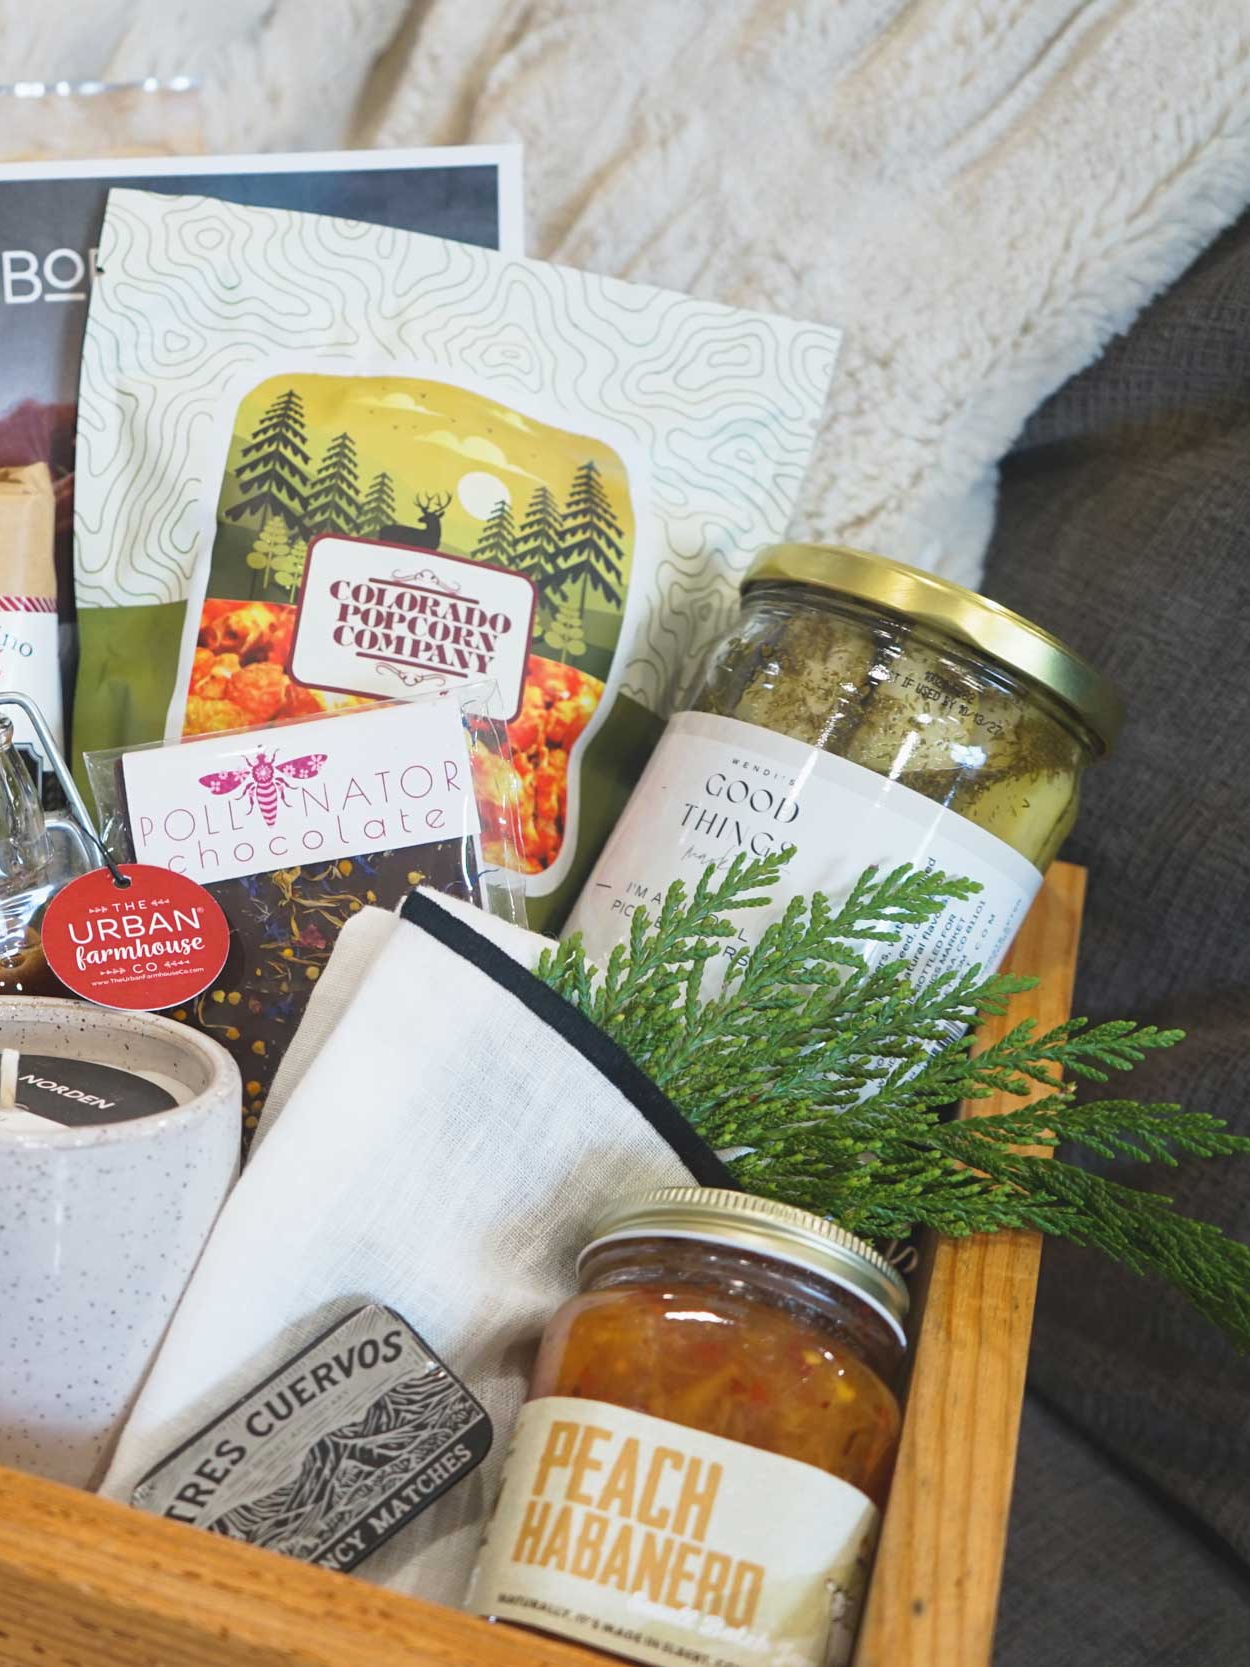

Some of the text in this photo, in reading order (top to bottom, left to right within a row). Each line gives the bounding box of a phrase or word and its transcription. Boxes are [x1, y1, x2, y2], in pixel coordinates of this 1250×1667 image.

[329, 580, 511, 634] COLORADO
[337, 603, 498, 652] POPCORN
[333, 625, 494, 674] COMPANY
[731, 758, 796, 787] WENDI'S
[705, 773, 800, 824] GOOD
[168, 808, 446, 874] chocolate
[112, 900, 148, 913] THE
[626, 881, 662, 905] I'M A
[68, 907, 201, 945] URBAN
[940, 917, 967, 967] MARKET
[941, 913, 957, 940] FOR
[76, 936, 206, 971] farmhouse
[132, 962, 158, 974] CO
[904, 941, 926, 980] atural
[18, 1074, 116, 1111] NORDEN
[164, 1438, 247, 1525] TRES
[245, 1330, 403, 1437] CUERVOS
[370, 1444, 473, 1536] MATCHES
[532, 1420, 725, 1542] PEACH
[512, 1501, 767, 1629] HABANERO
